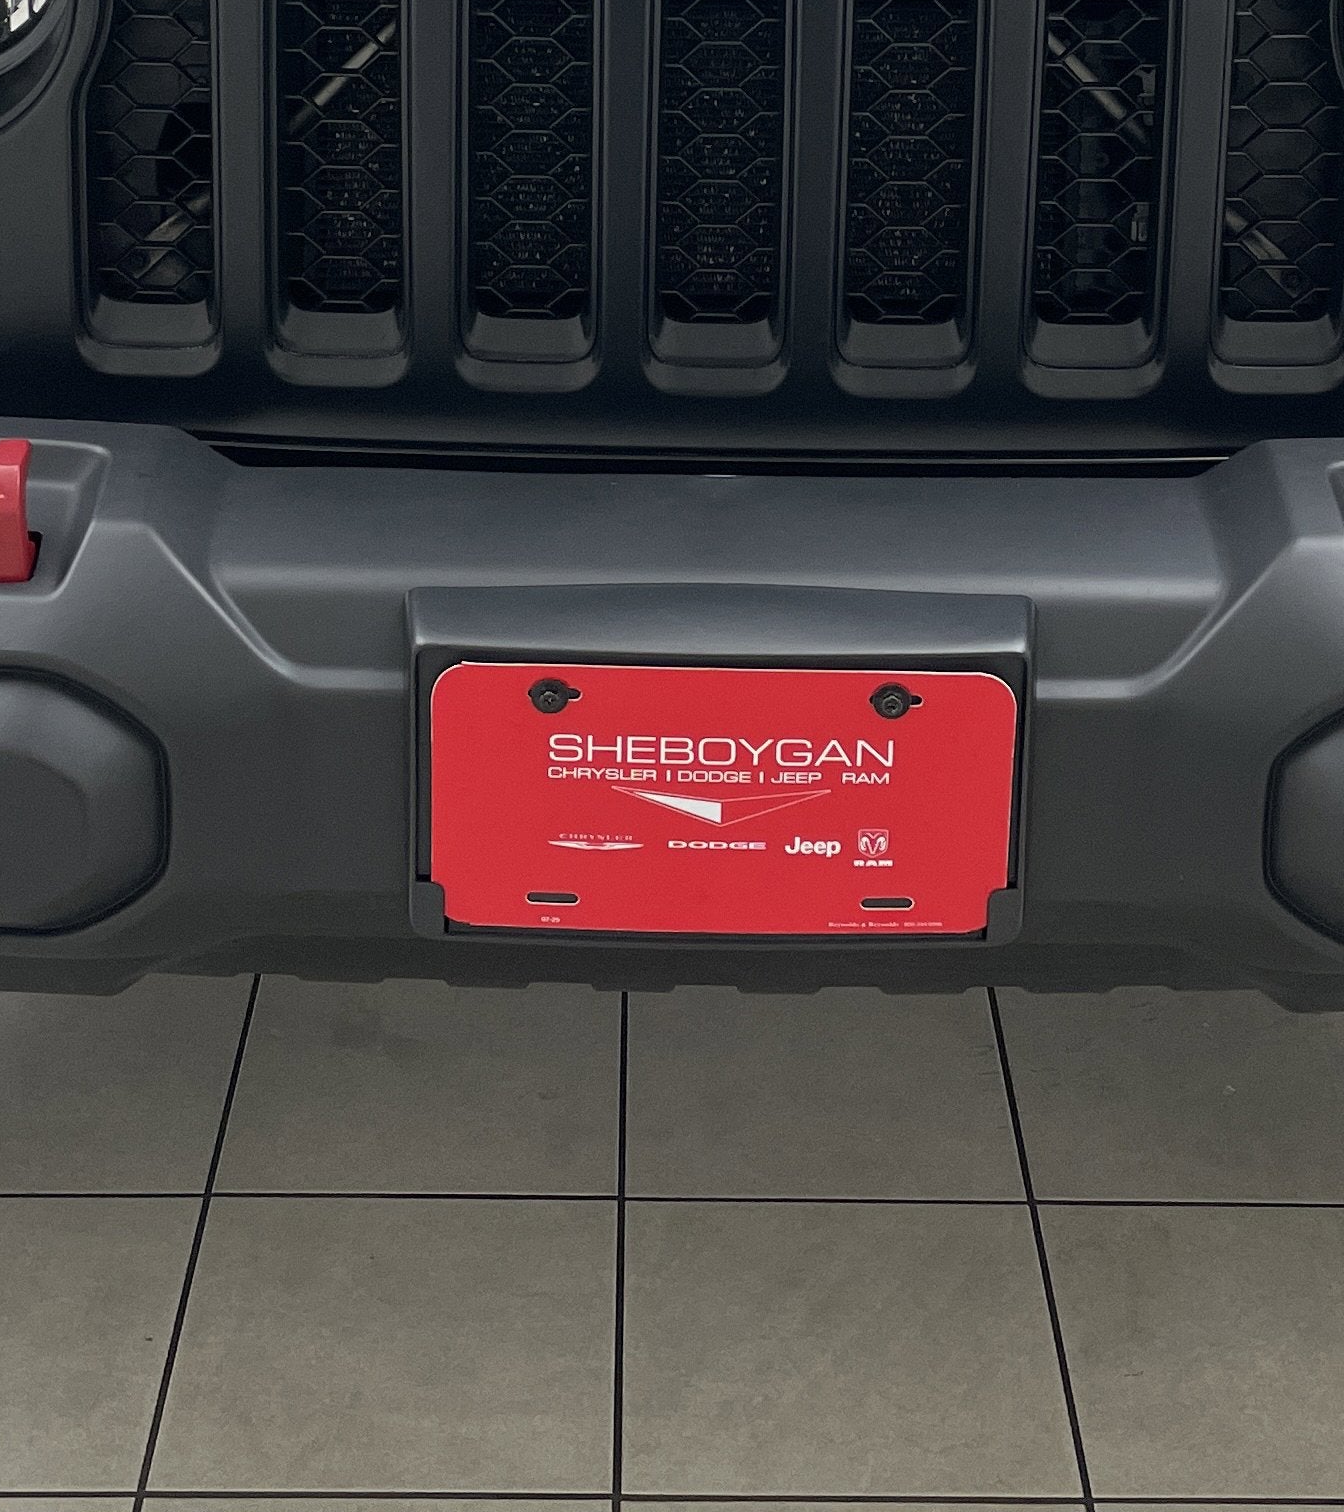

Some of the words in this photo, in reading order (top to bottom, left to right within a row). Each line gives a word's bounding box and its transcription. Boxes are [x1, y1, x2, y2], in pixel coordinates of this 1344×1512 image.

[548, 733, 894, 768] SHEBOYGAN
[548, 766, 657, 781] CHRYSLER
[678, 770, 752, 783] DODGE
[770, 771, 822, 784] JEEP
[841, 772, 891, 784] RAM
[667, 840, 767, 850] DODGE
[784, 836, 842, 858] Jeep
[853, 859, 894, 867] RAM
